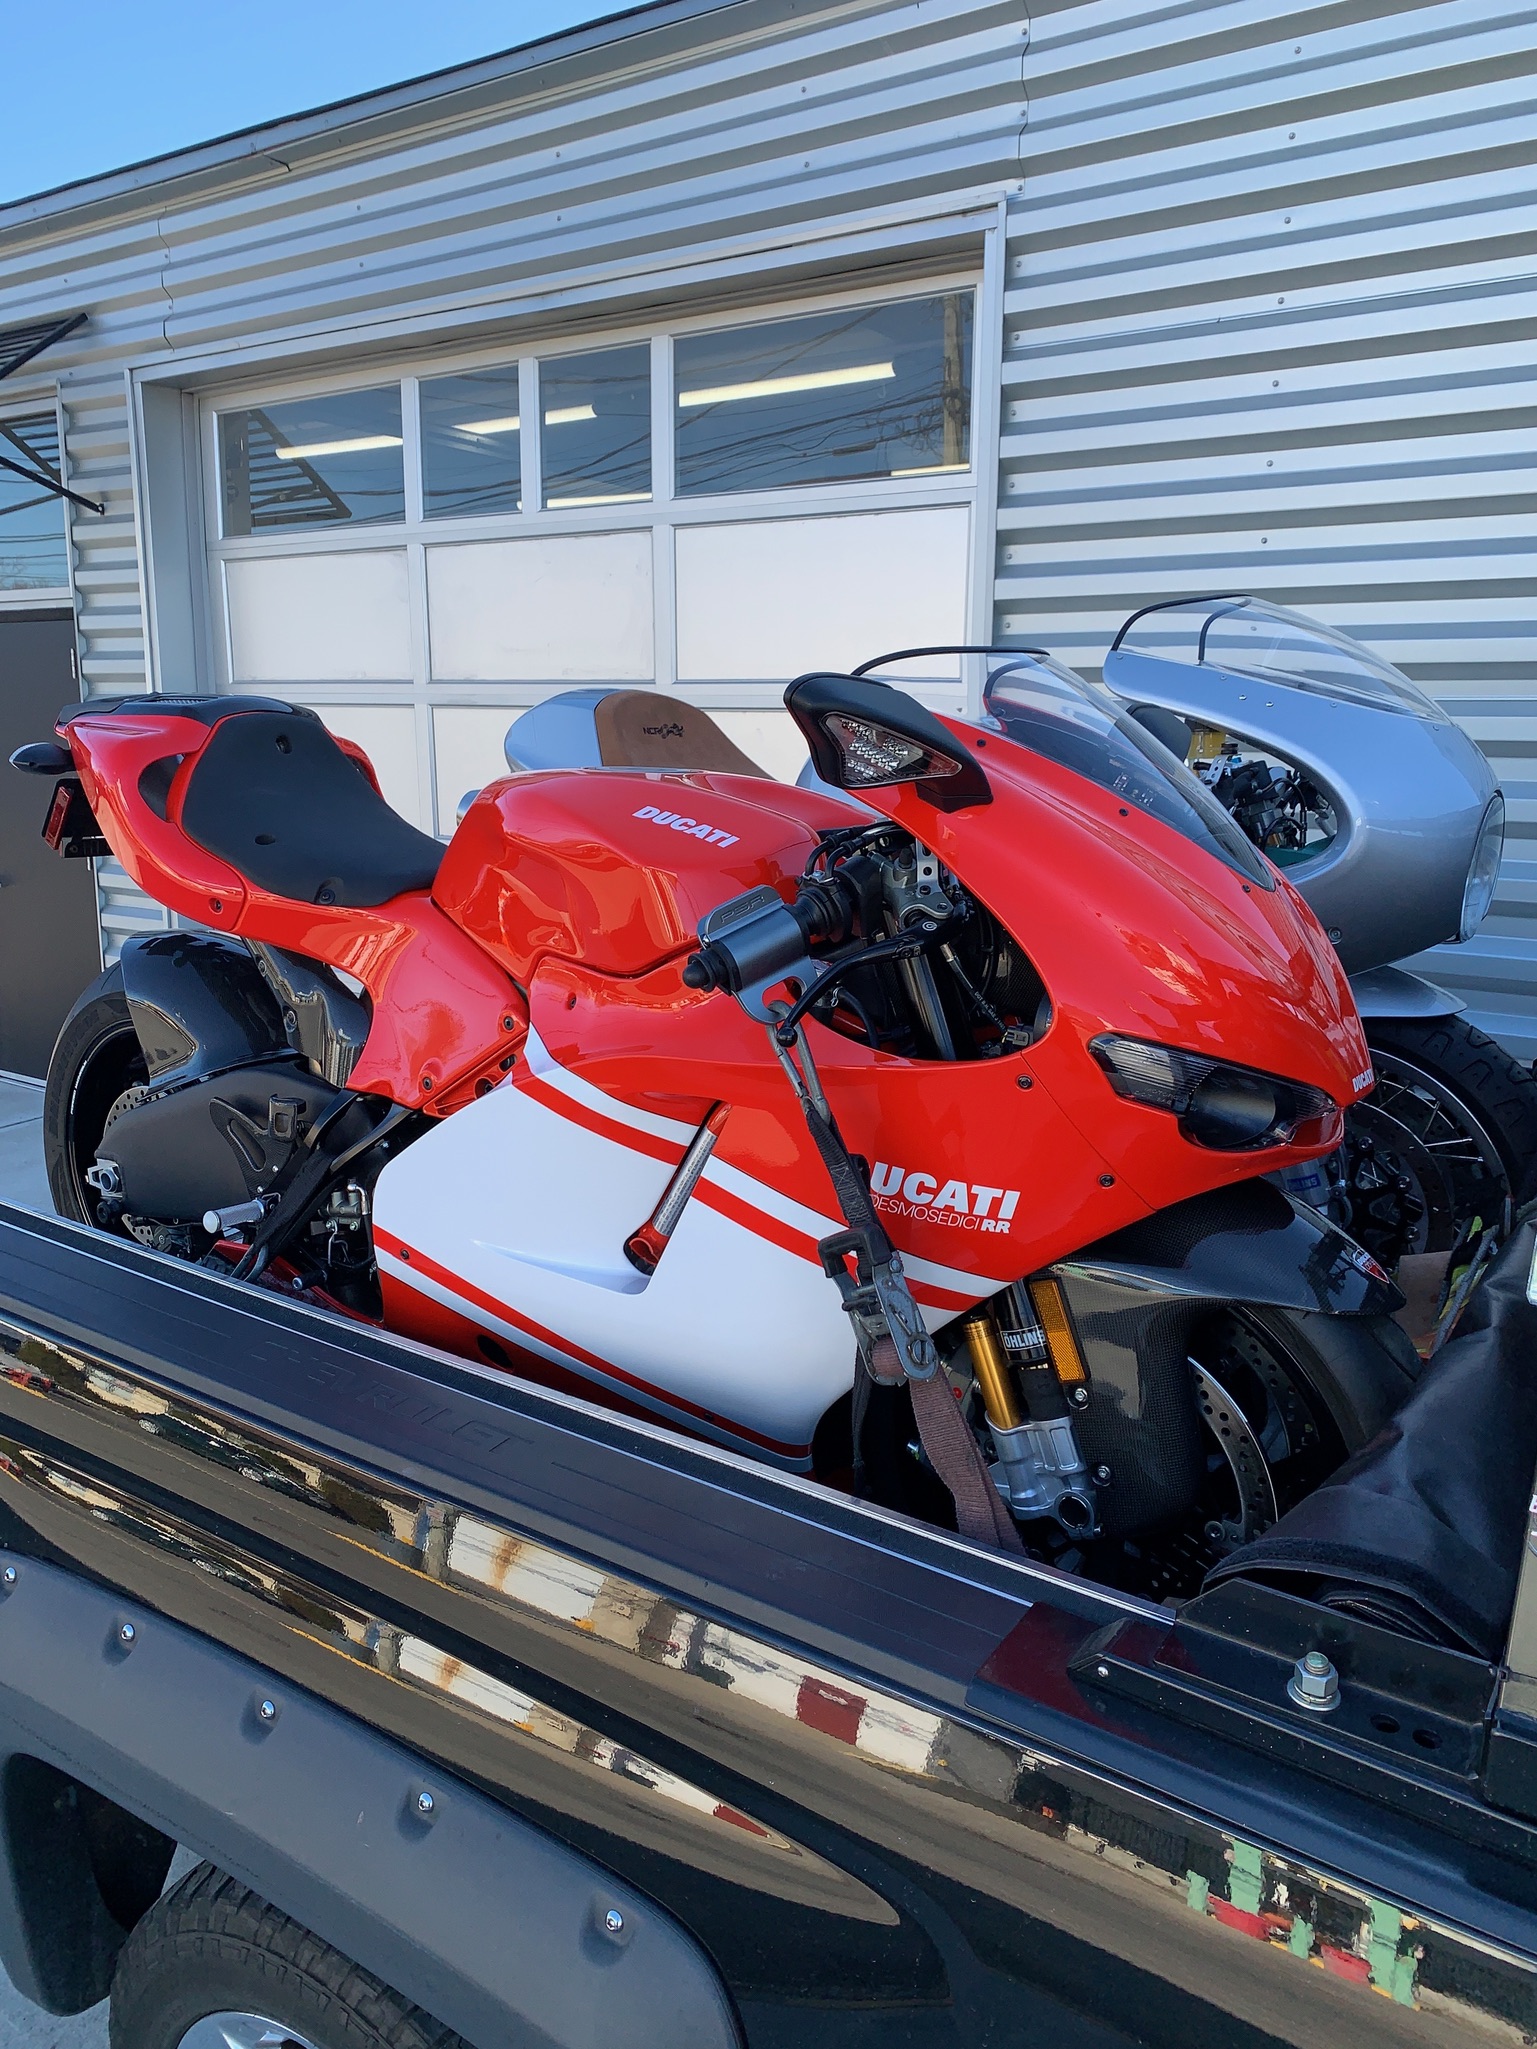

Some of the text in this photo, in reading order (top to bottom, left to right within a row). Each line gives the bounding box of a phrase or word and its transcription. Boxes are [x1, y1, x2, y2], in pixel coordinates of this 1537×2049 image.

[632, 805, 741, 849] DUCATI
[869, 1161, 1021, 1220] UCATI
[869, 1193, 1012, 1234] DESMOSEDICI RR
